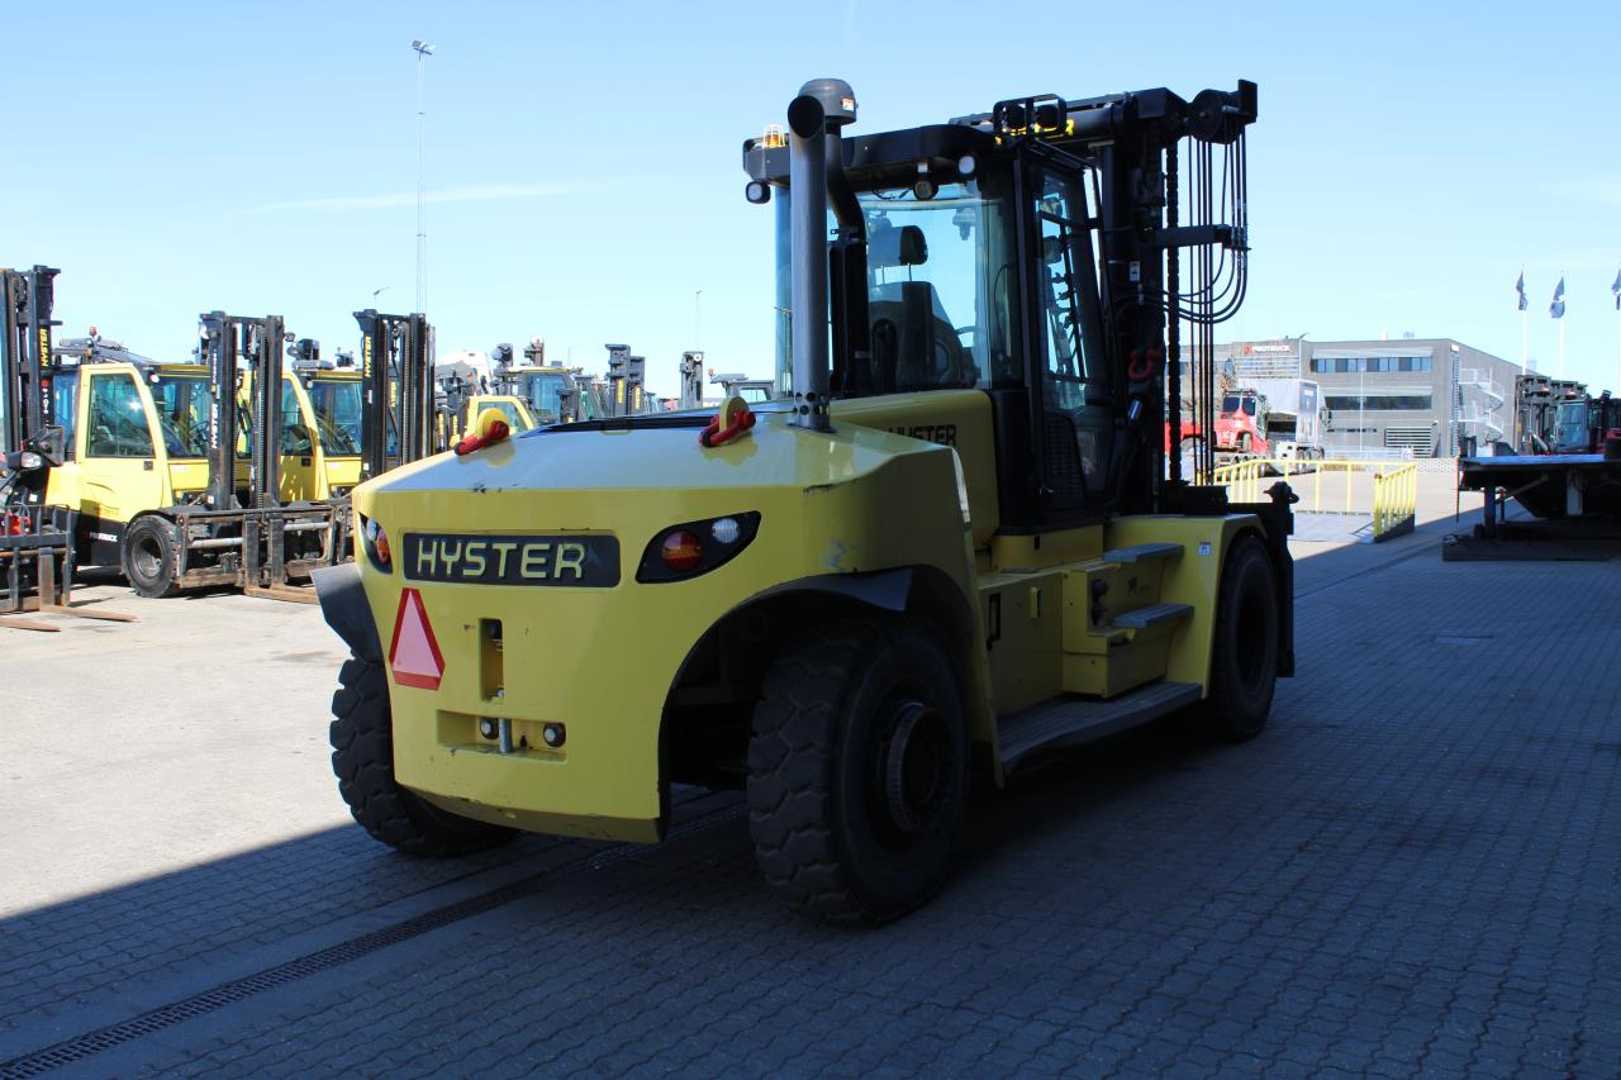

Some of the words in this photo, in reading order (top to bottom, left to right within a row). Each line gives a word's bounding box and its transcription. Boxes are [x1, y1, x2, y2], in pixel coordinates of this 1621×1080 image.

[40, 328, 49, 367] HYSTER
[210, 403, 218, 449] HYSTER
[417, 539, 585, 578] HYSTER
